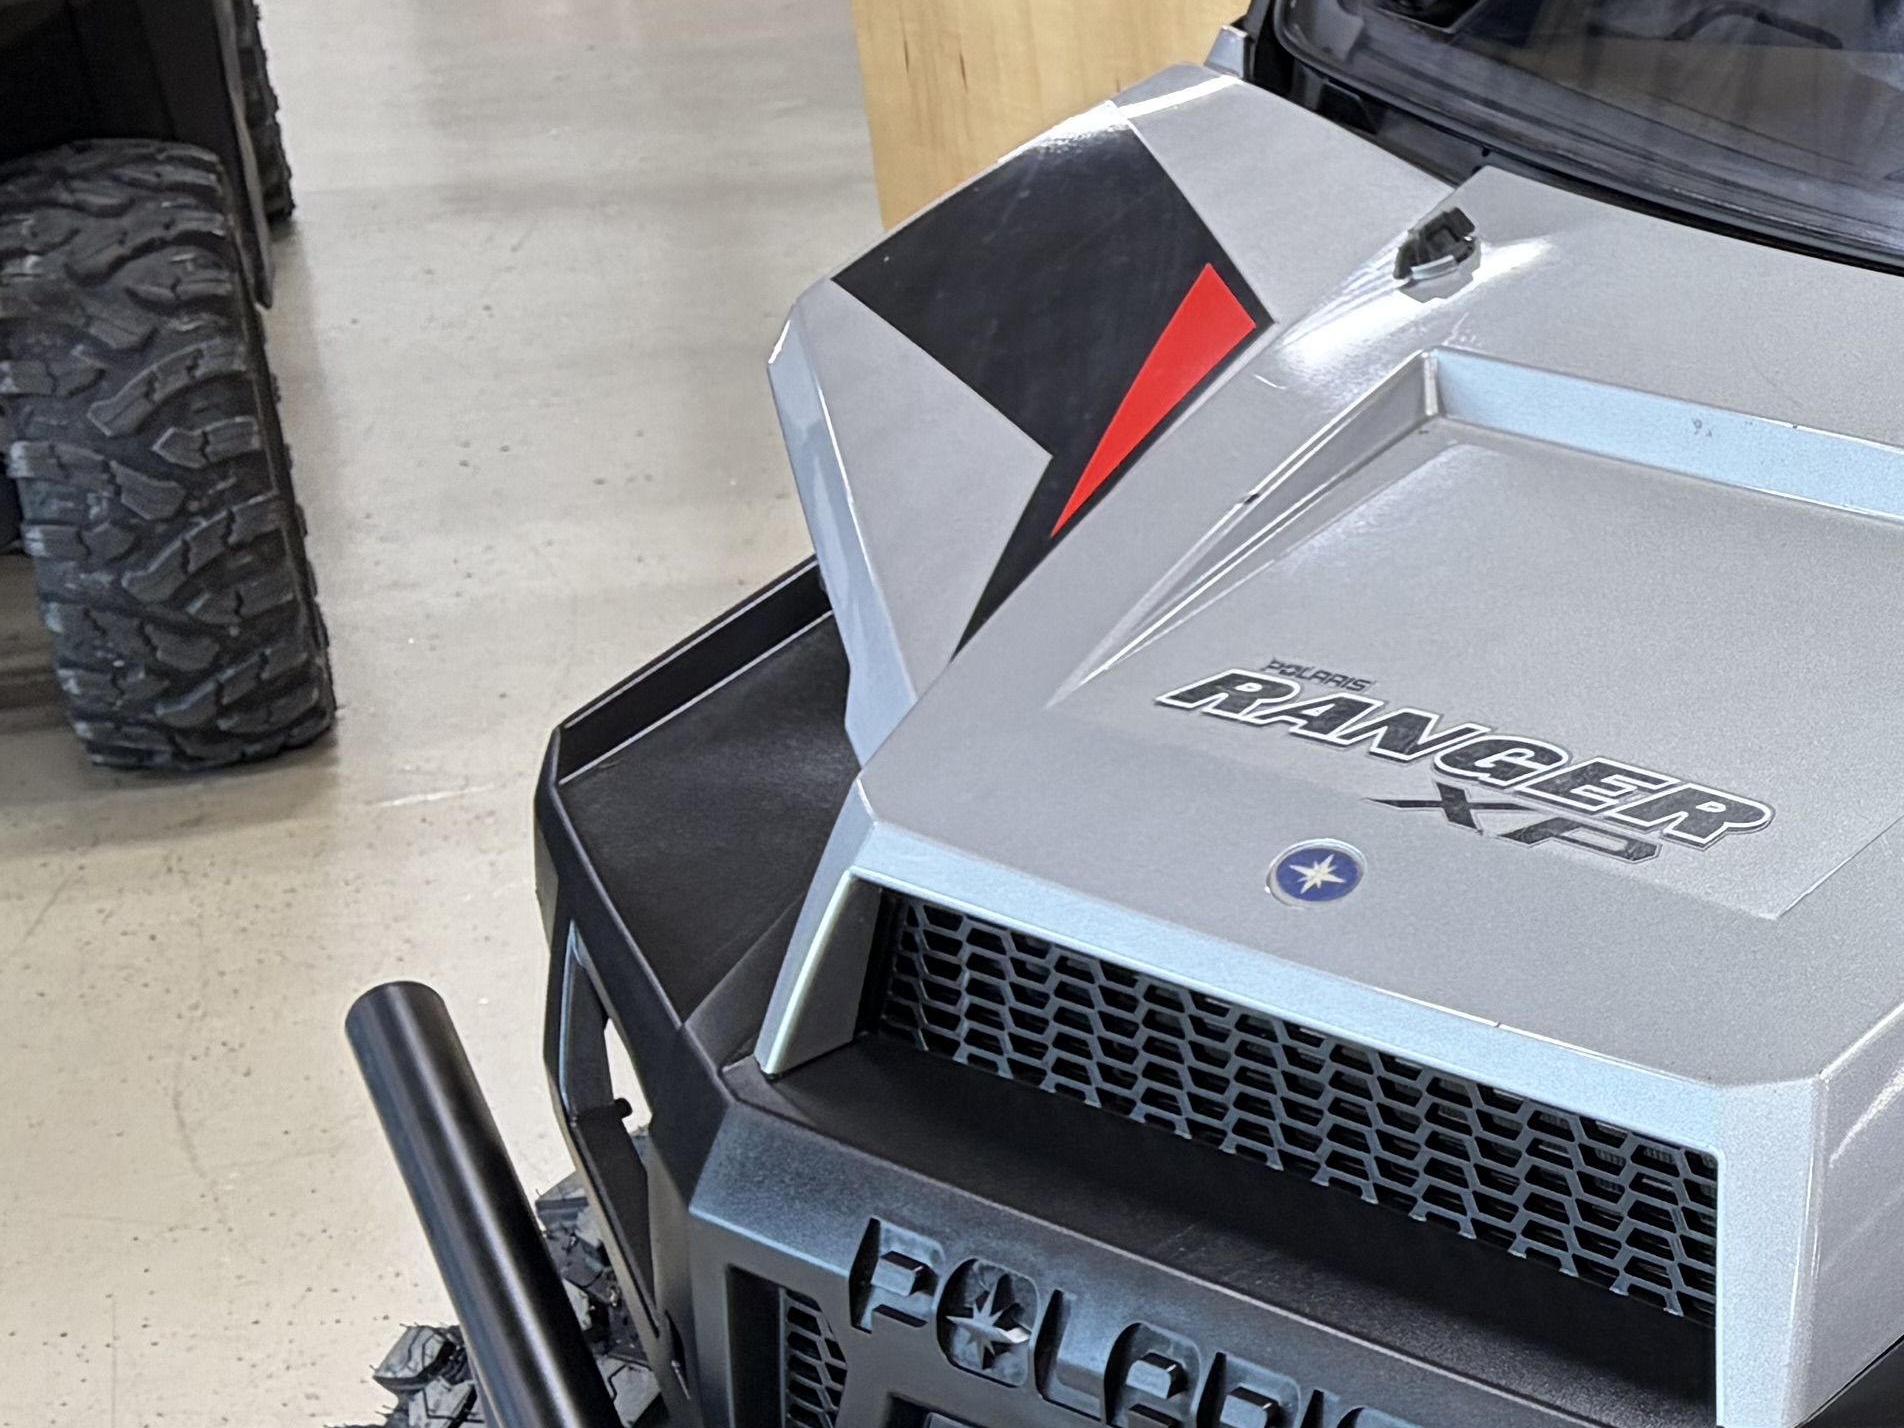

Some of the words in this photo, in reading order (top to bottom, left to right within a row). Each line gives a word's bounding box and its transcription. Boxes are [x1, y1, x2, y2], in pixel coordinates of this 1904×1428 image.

[1262, 657, 1377, 693] POLARIS
[1154, 668, 1776, 852] RANGER
[1363, 781, 1661, 864] XP
